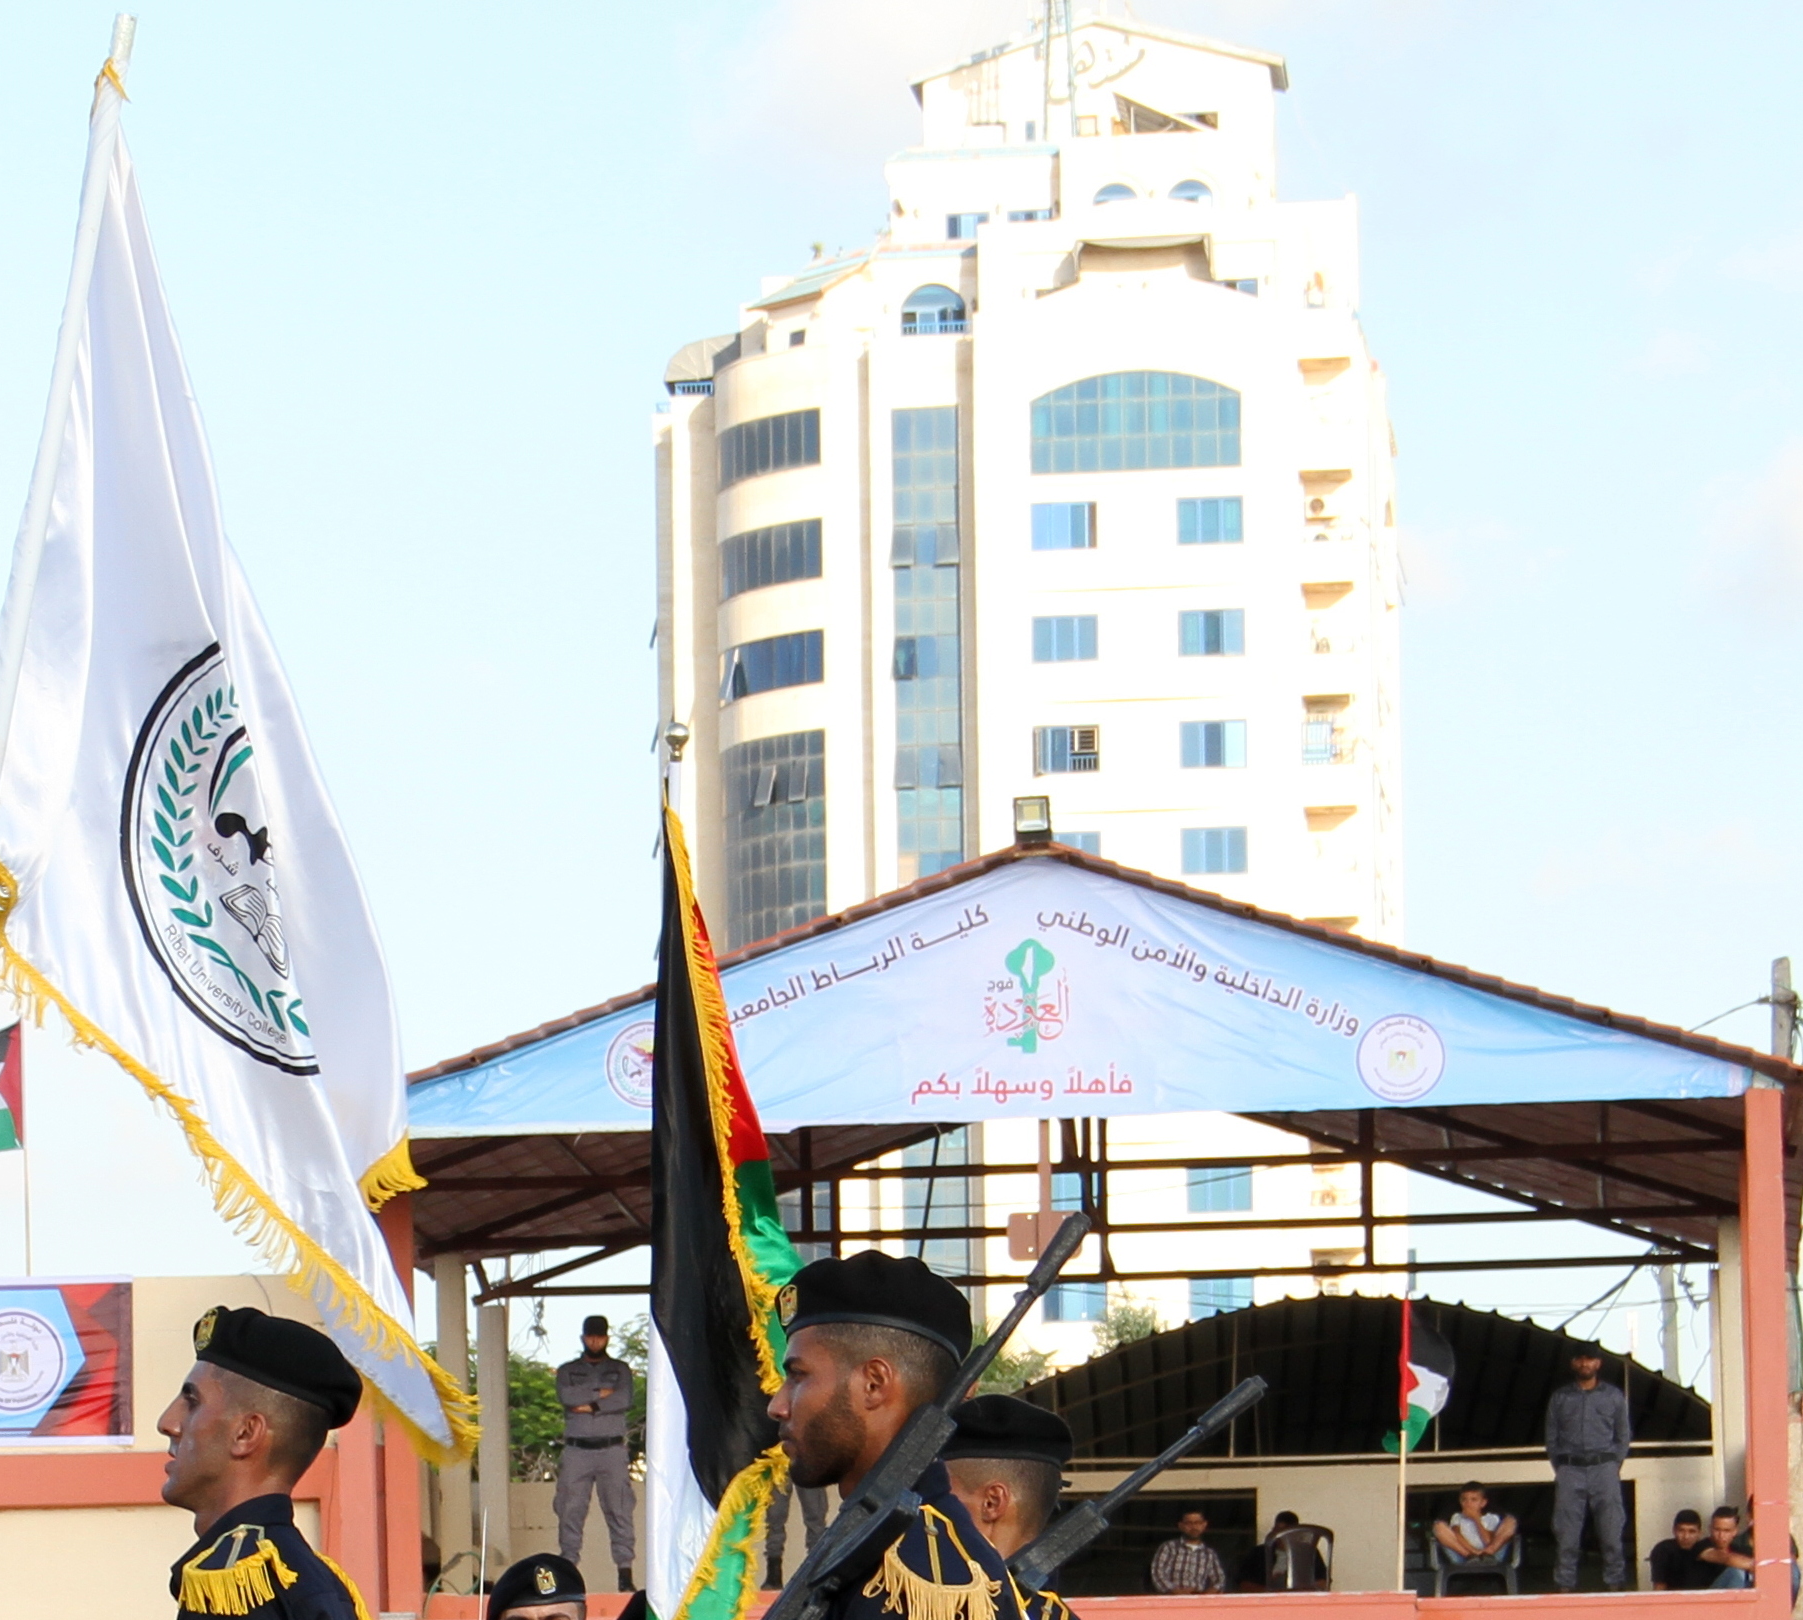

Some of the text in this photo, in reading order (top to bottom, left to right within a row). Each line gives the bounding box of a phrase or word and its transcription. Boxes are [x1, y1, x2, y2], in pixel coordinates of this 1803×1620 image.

[164, 923, 287, 1044] Ribat University College
[729, 903, 990, 1028] كلية الرباط الجامعي
[1036, 908, 1360, 1037] وزارة الداخلية والأمن الوطني
[911, 1072, 961, 1105] بكم
